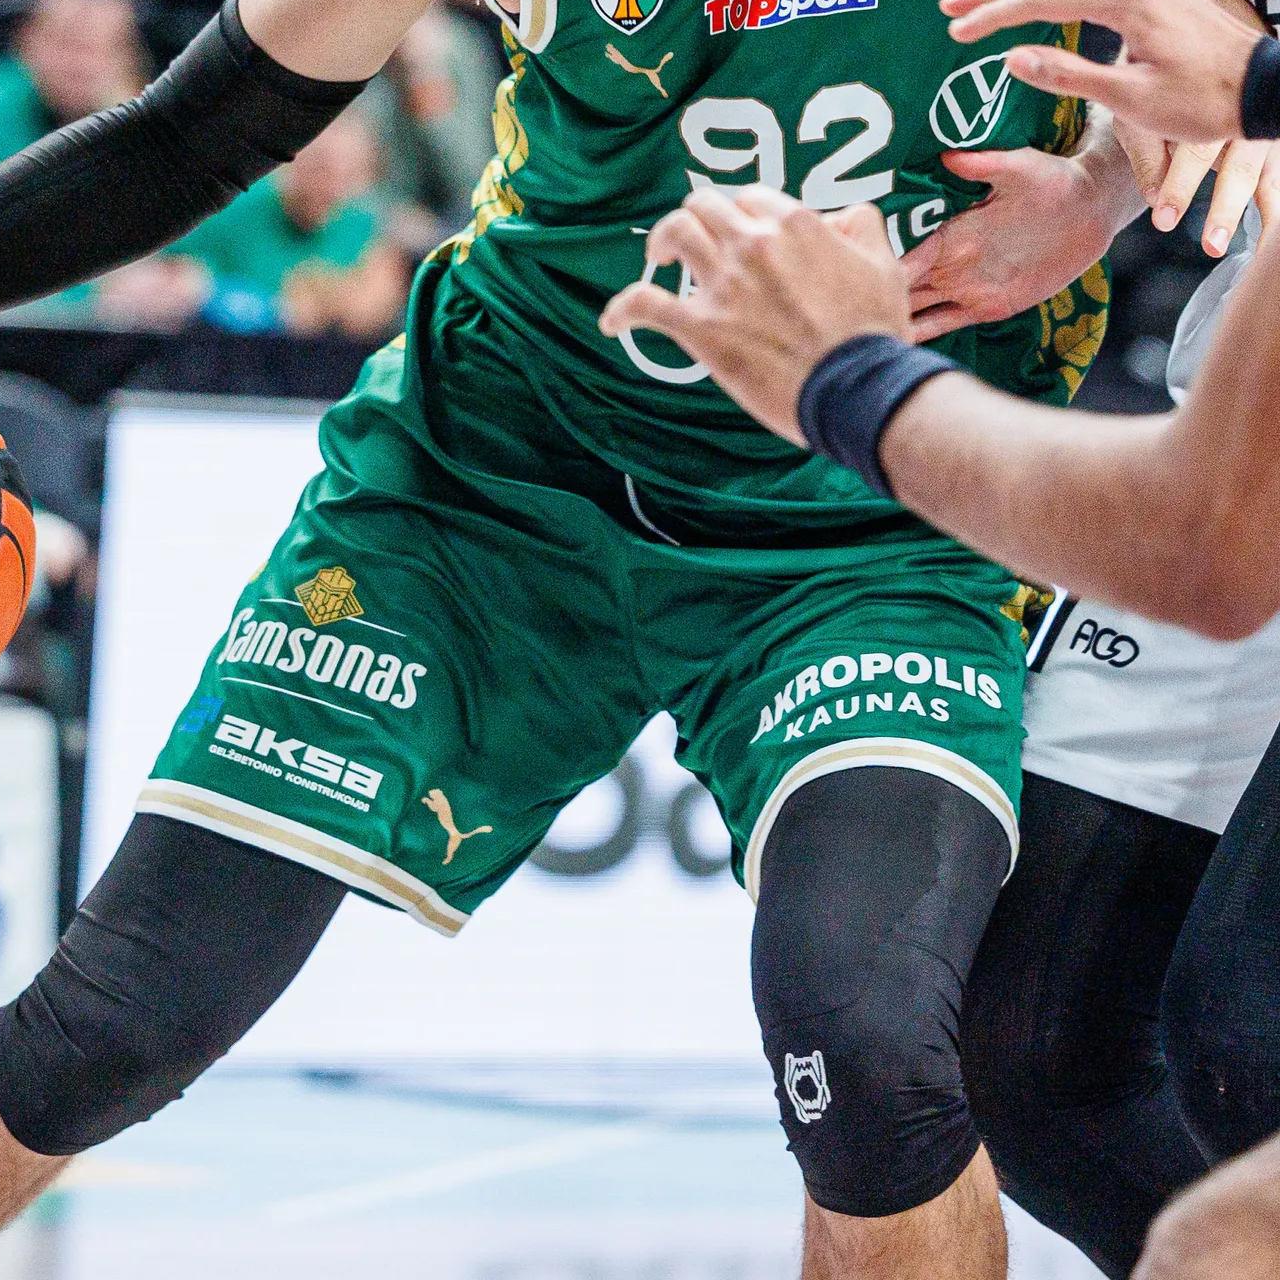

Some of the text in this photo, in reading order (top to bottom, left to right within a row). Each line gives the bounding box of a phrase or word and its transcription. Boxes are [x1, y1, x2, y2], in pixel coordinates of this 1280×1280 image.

[678, 81, 895, 211] 92
[749, 652, 1002, 744] AKROPOLIS
[783, 692, 950, 742] KAUNAS
[214, 714, 384, 799] aksa
